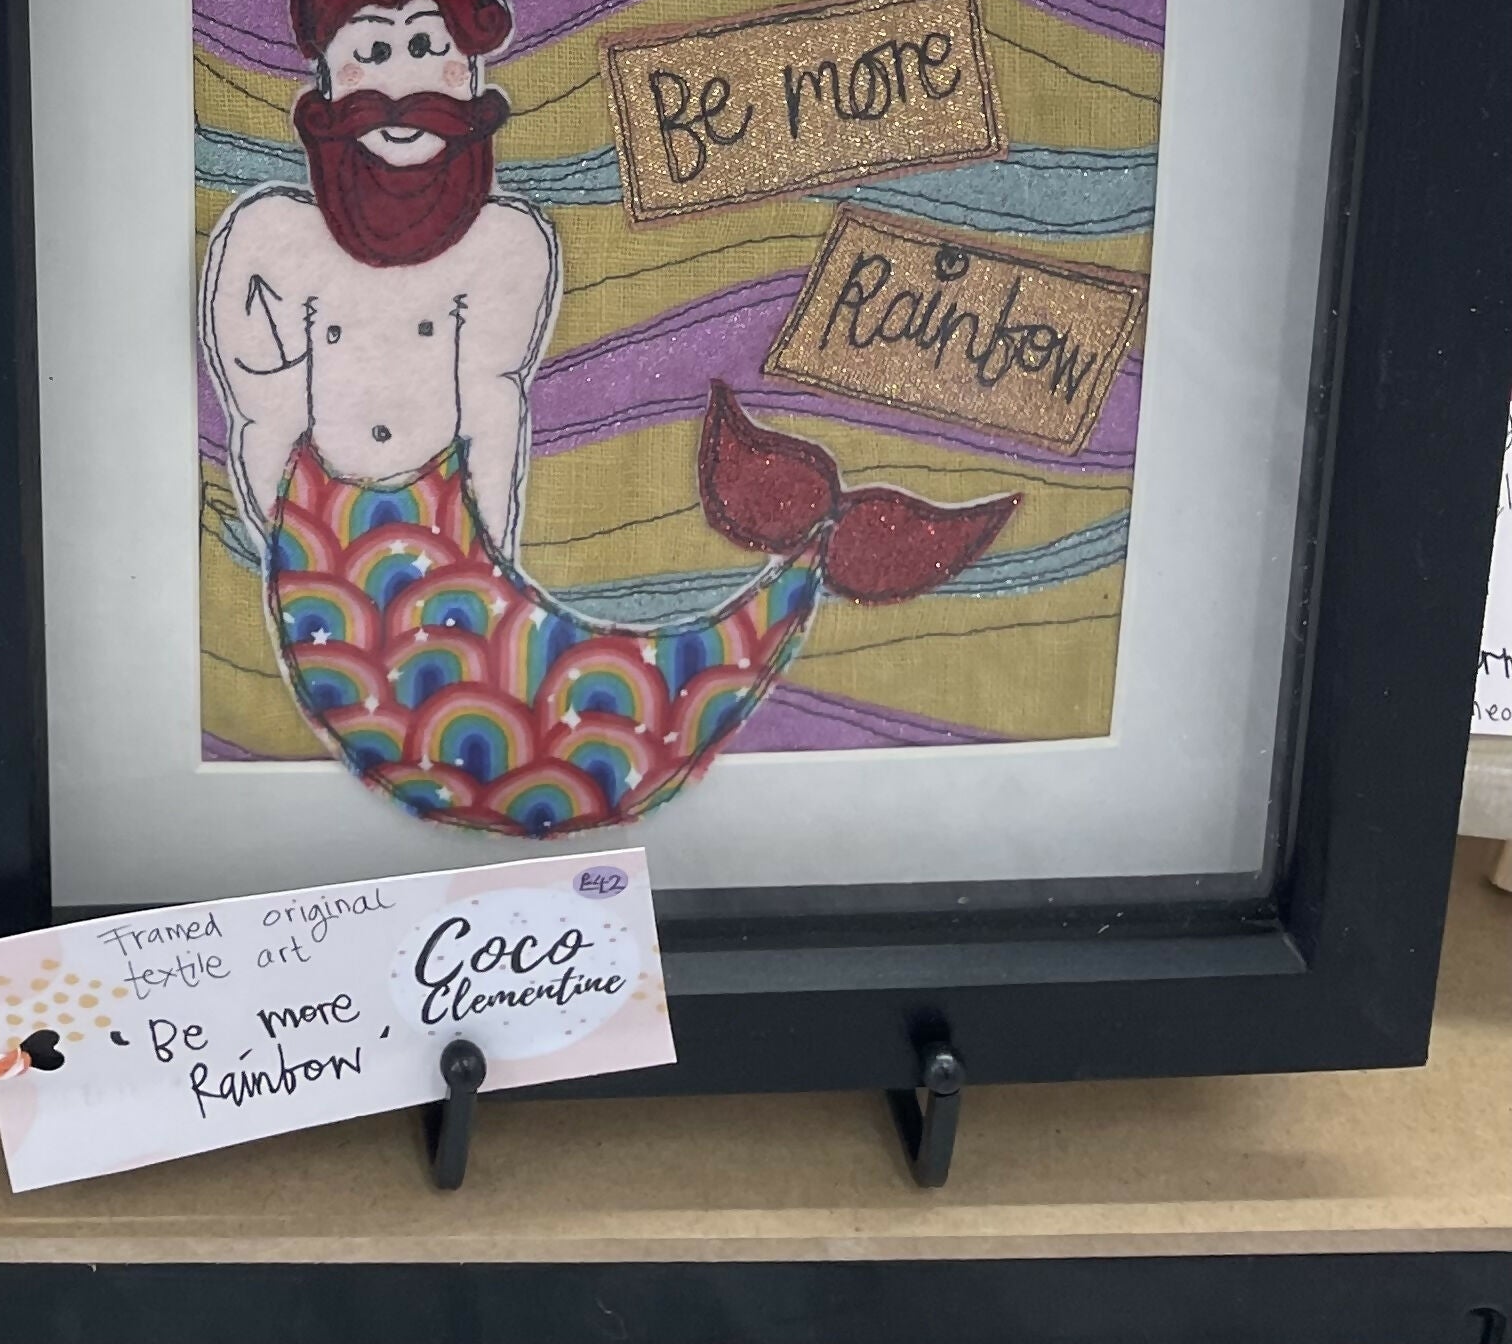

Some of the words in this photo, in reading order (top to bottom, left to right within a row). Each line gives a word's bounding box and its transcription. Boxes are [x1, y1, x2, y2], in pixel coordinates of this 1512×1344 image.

[649, 67, 752, 185] Be
[785, 30, 963, 139] more
[818, 244, 1101, 404] Rainbow
[97, 911, 223, 957] Framed
[262, 888, 397, 943] original
[414, 916, 595, 988] Coco
[123, 949, 232, 1001] textile
[257, 935, 312, 969] art
[421, 965, 627, 1025] Clementine
[256, 992, 361, 1040] more
